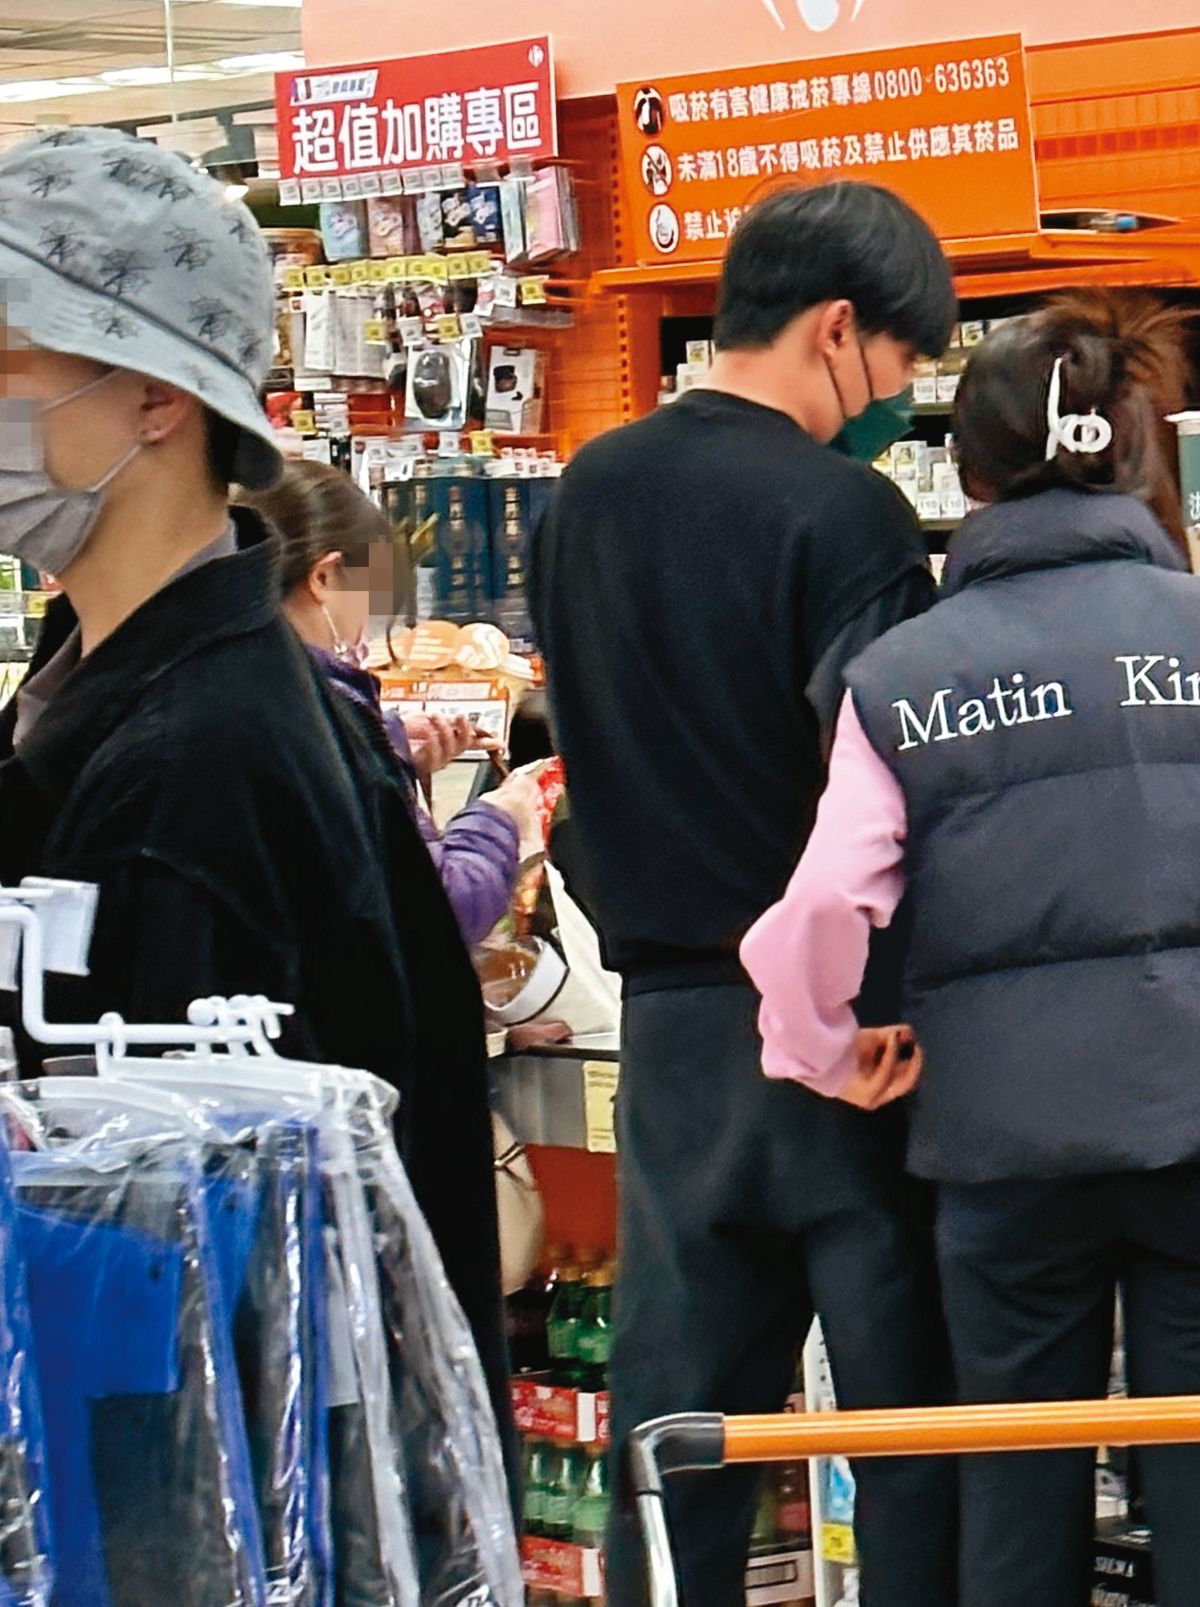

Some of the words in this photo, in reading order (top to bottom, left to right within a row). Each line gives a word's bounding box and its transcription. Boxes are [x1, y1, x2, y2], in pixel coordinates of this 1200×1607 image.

[291, 81, 542, 175] 超值加購專區
[891, 673, 1073, 751] Matin
